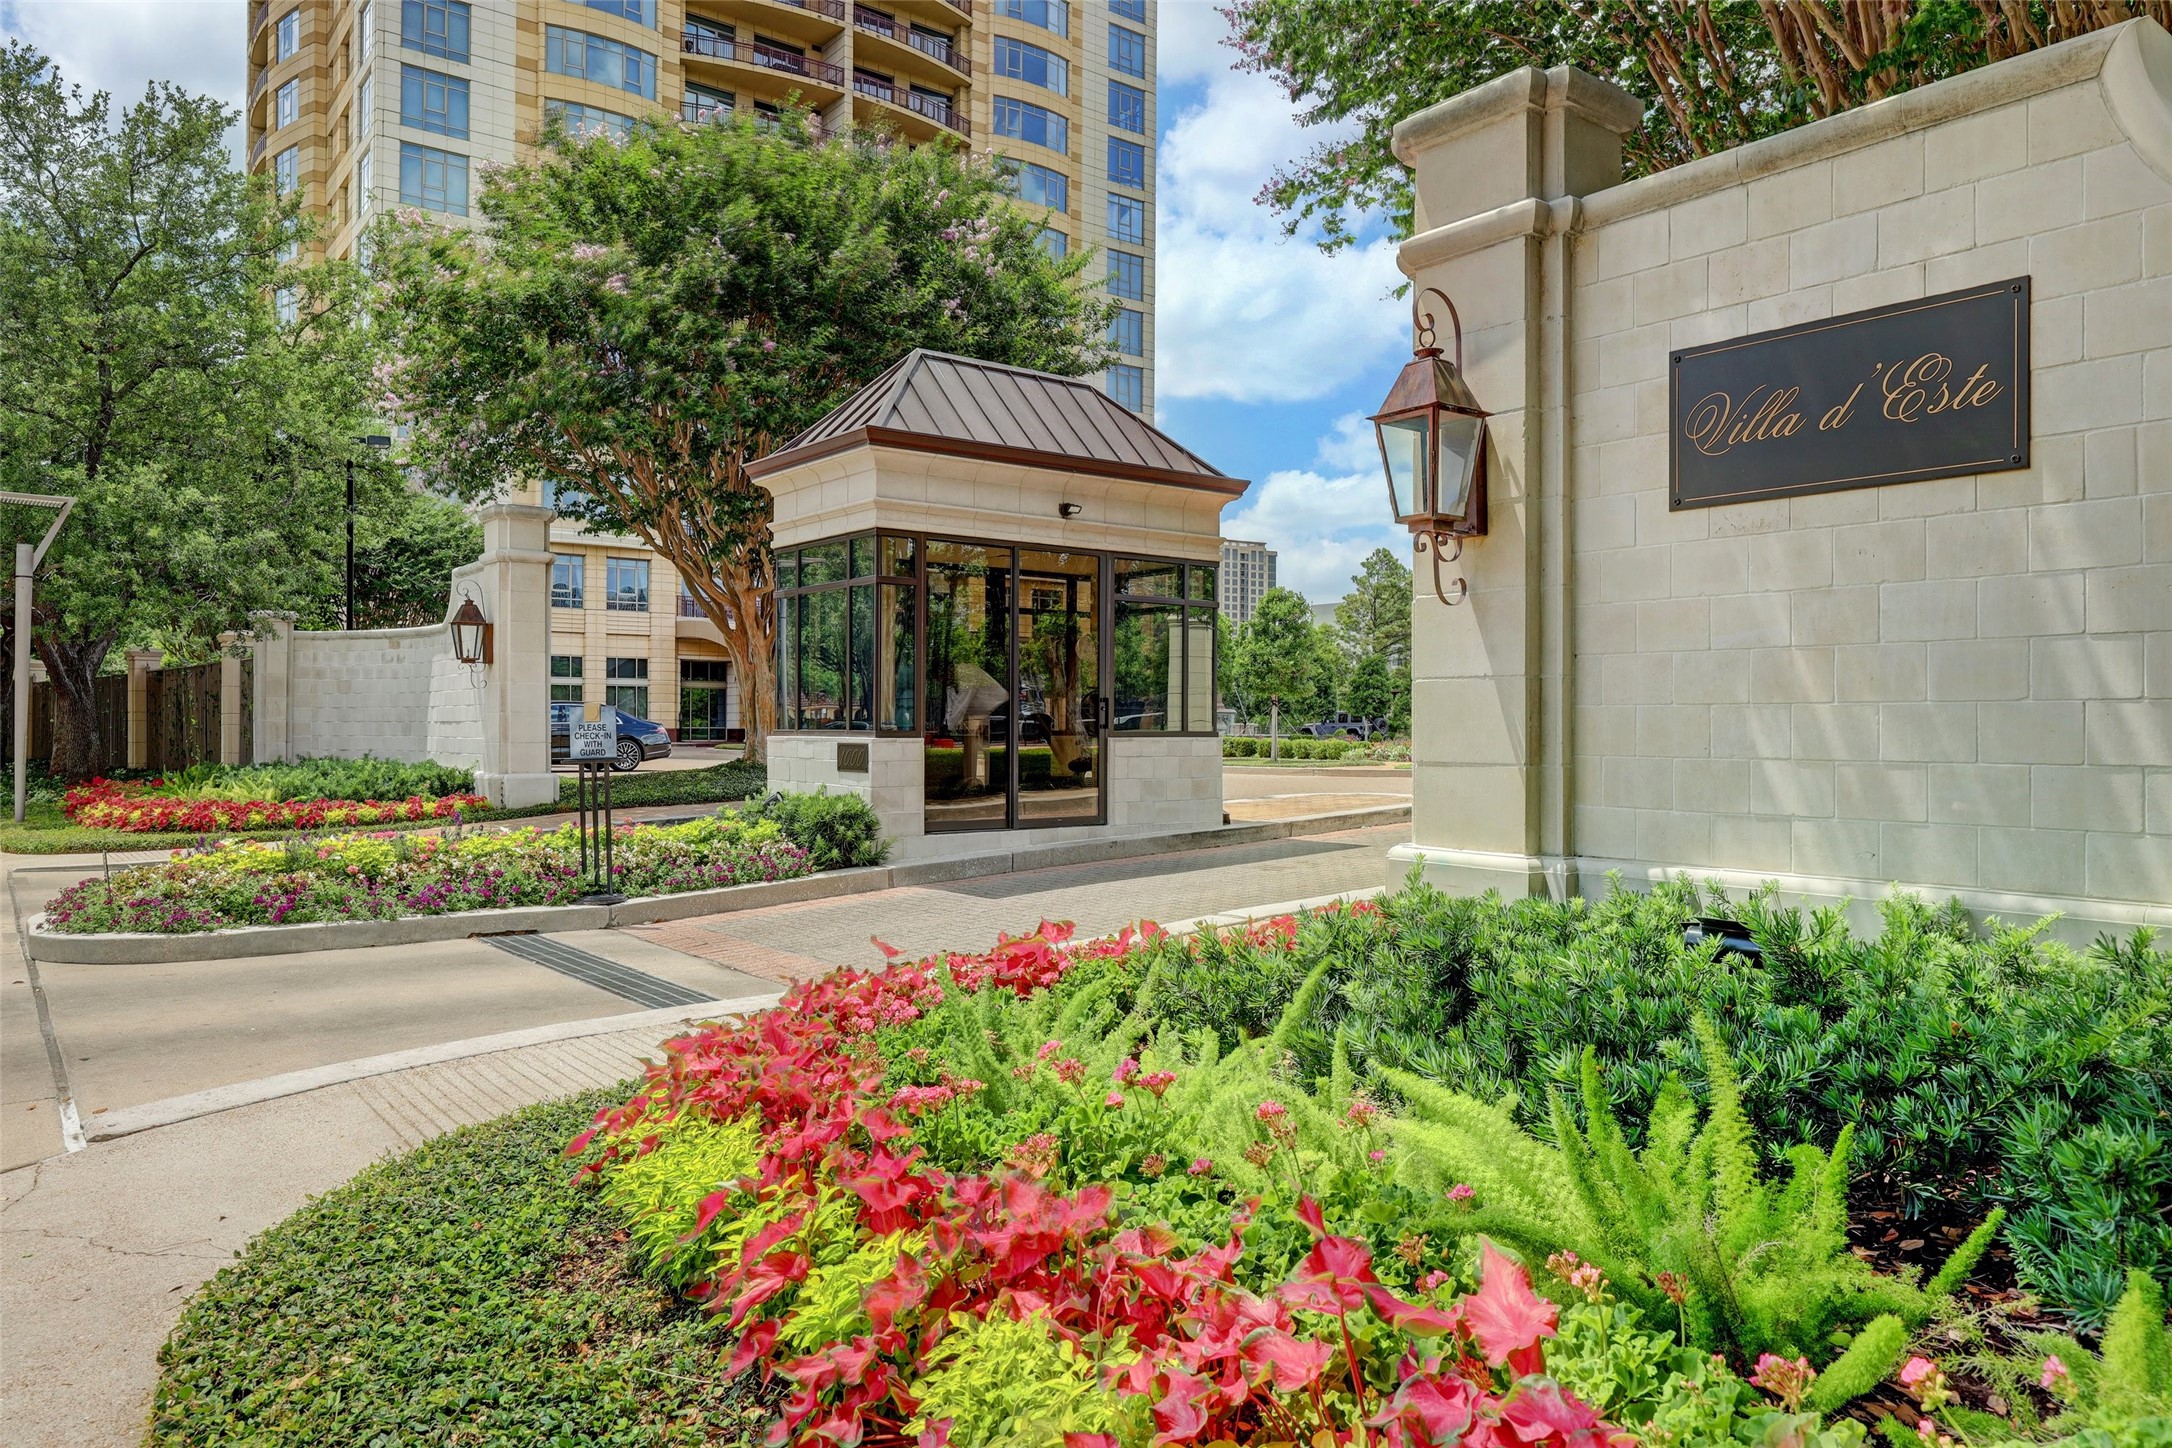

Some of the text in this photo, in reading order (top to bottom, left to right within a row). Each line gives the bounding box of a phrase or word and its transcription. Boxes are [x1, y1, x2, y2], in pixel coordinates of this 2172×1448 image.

[1685, 384, 1807, 457] Villa
[578, 724, 606, 732] PLEASE
[580, 748, 606, 756] GUARD
